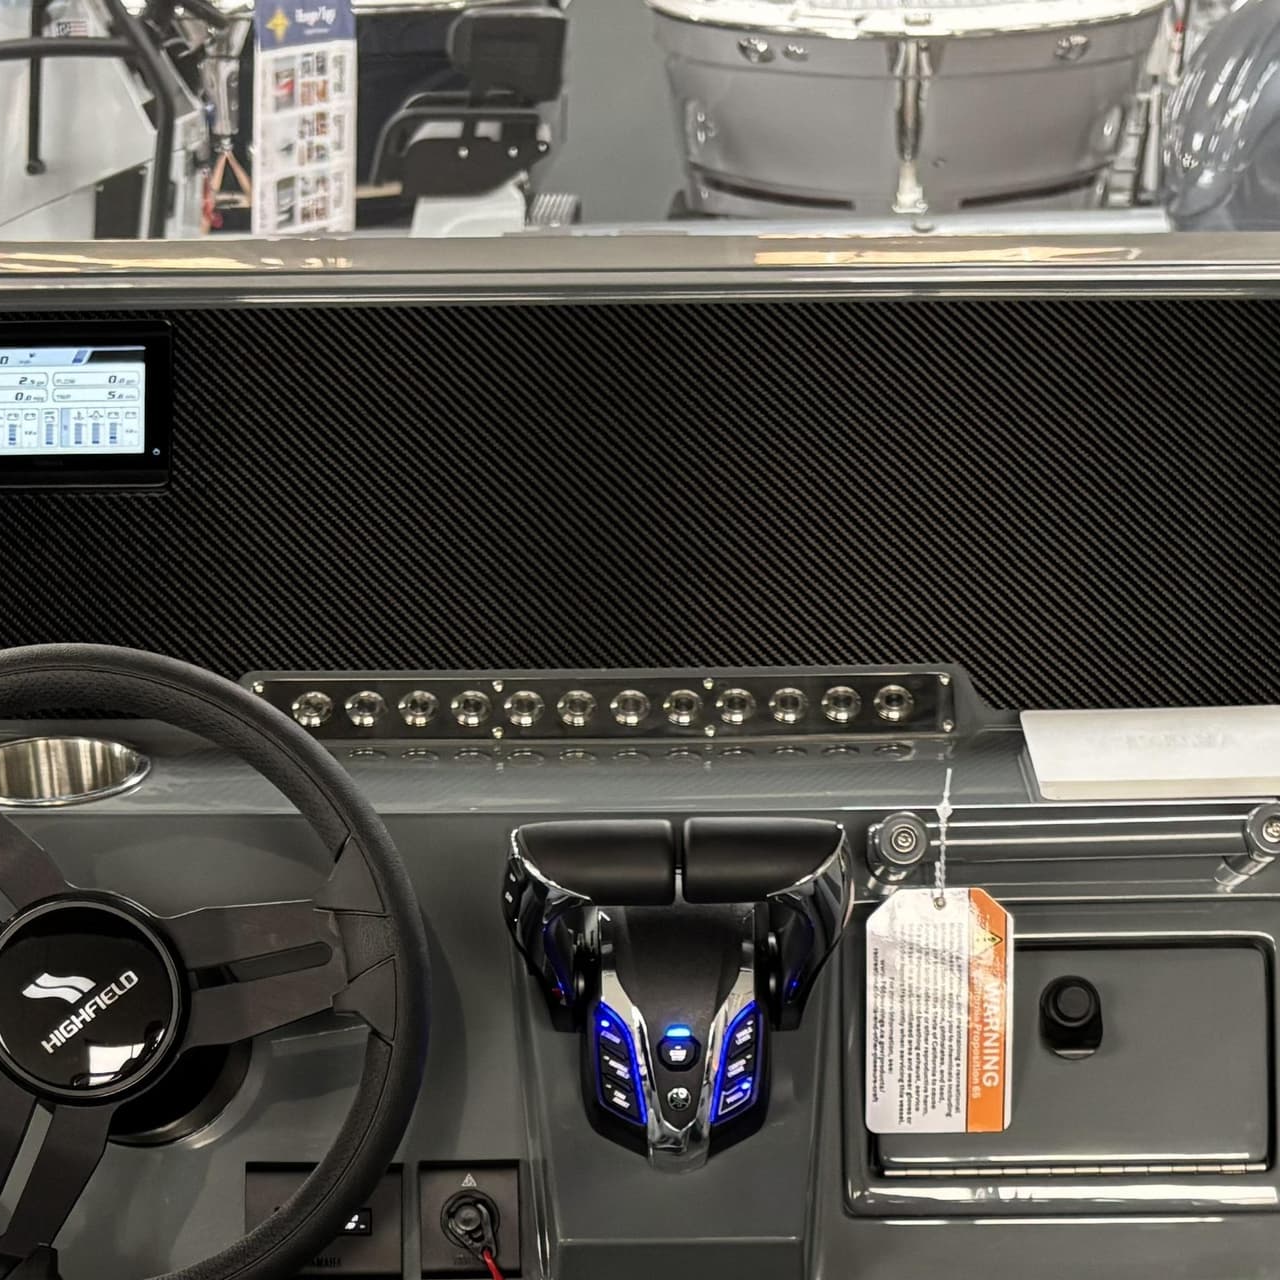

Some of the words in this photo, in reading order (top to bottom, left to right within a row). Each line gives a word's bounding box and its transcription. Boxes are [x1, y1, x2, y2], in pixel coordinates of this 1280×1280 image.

[40, 970, 140, 1054] HIGHFIELD
[982, 981, 1001, 1088] WARNING
[971, 1023, 982, 1086] Proposition
